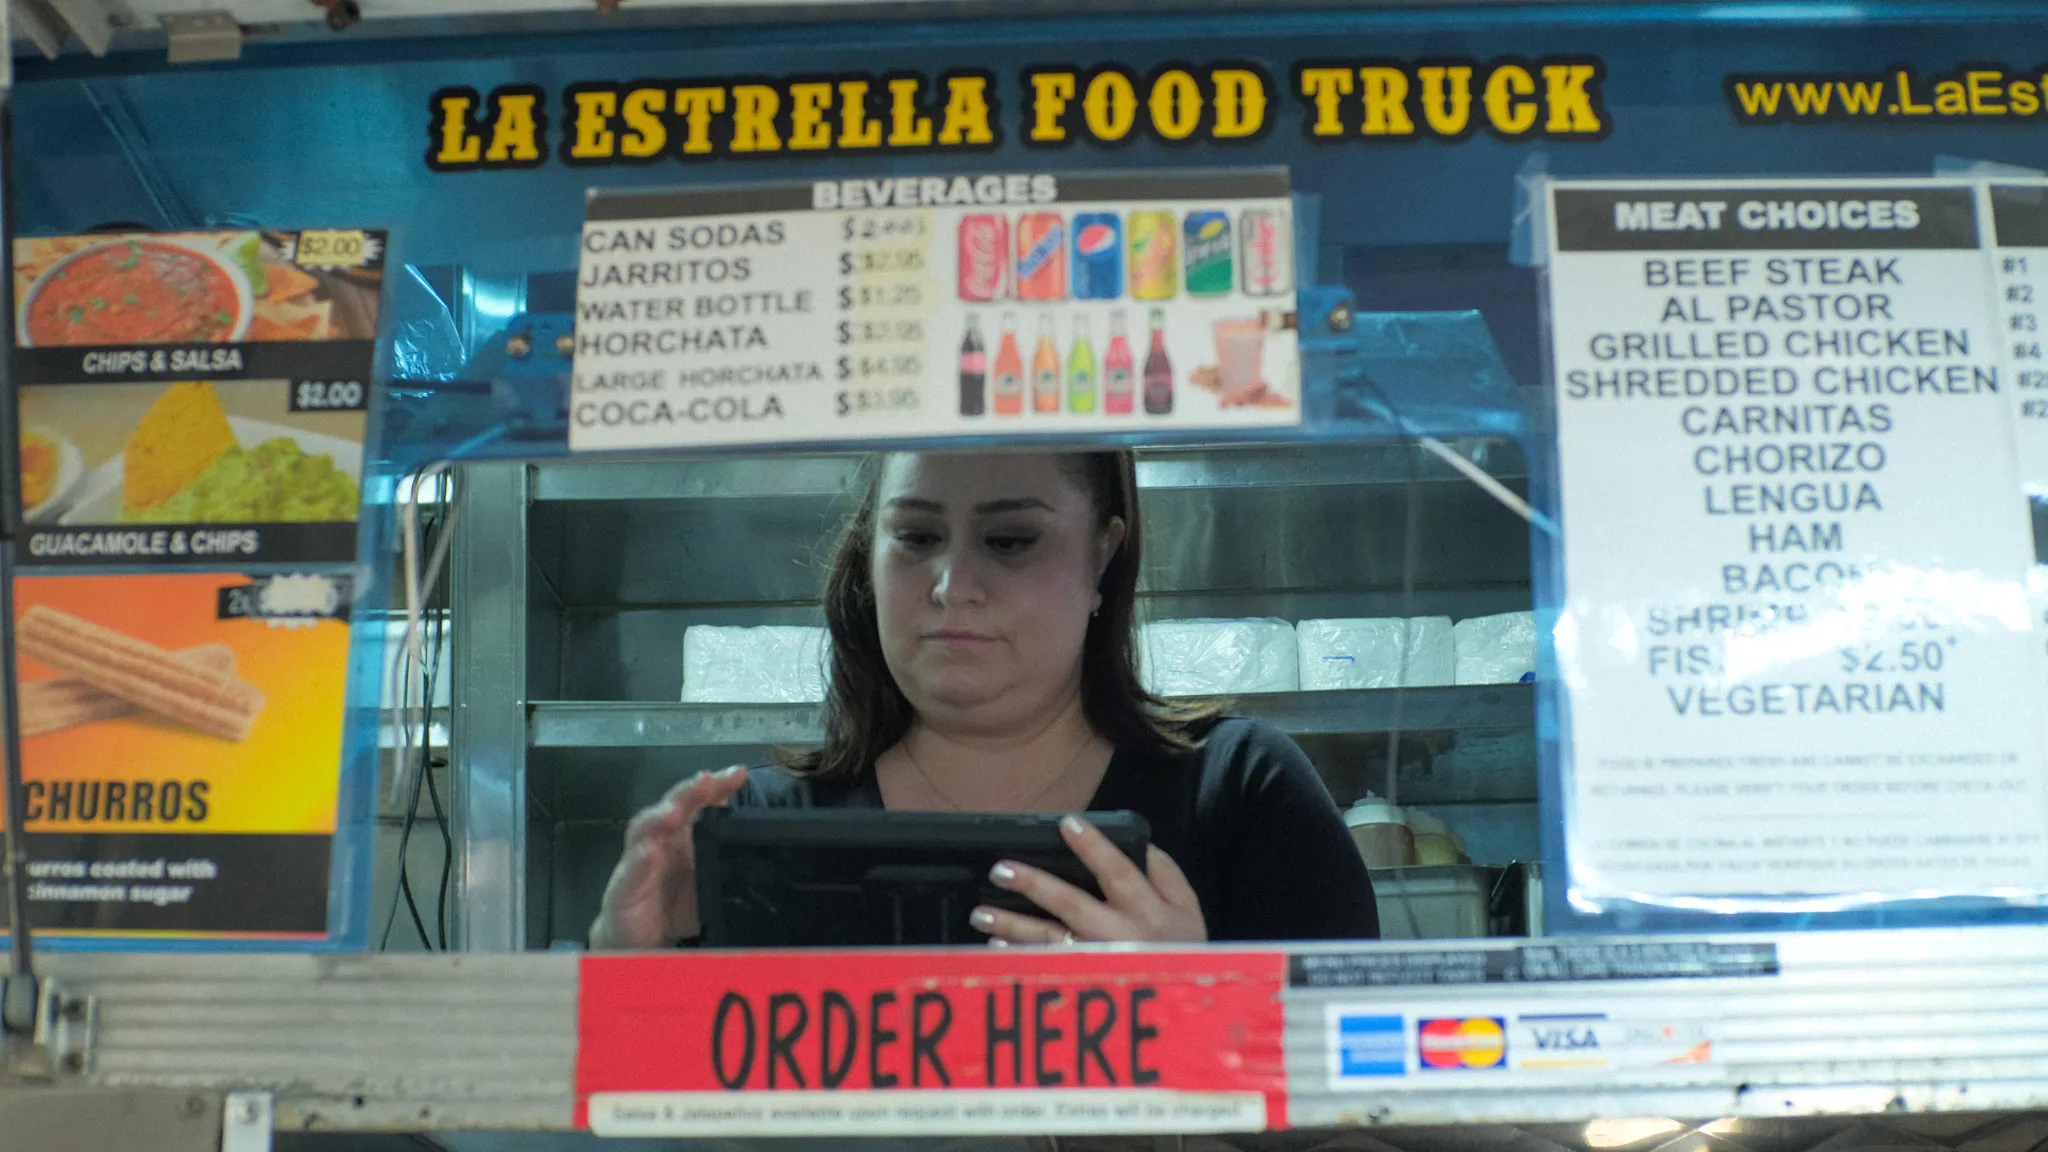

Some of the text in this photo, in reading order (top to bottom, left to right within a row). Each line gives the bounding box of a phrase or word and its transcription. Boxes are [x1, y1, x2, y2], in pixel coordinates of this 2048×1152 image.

[436, 64, 1601, 163] LA ESTRELLA FOOD TRUCK
[811, 174, 1058, 209] BEVERAGES
[1614, 199, 1921, 232] MEAT CHOICES
[583, 220, 786, 254] CAN SODAS
[581, 256, 752, 288] JARRITOS
[1643, 255, 1904, 288] BEEF STEAK
[2002, 257, 2028, 274] #1
[579, 289, 814, 322] WATER BOTTLE
[1659, 292, 1894, 324] AL PASTOR
[2005, 284, 2034, 303] #2
[2009, 312, 2038, 332] #3
[578, 323, 769, 358] HORCHATA
[1589, 327, 1971, 361] GRILLED CHICKEN
[2013, 341, 2042, 360] #4
[81, 348, 243, 375] CHIPS & SALSA
[574, 360, 824, 394] LARGE HORCHATA
[296, 382, 363, 409] $2.00
[1565, 365, 2001, 400] SHREDDED CHICKEN
[574, 394, 786, 428] COCA-COLA
[1680, 403, 1894, 437] CARNITAS
[1692, 441, 1888, 476] CHORIZO
[1703, 480, 1883, 517] LENGUA
[29, 530, 260, 556] GUACAMOLE & CHIPS
[1747, 520, 1843, 554] HAM
[1648, 644, 1725, 676] FIS
[1666, 682, 1947, 717] VEGETARIAN
[22, 779, 210, 823] CHURROS
[89, 857, 166, 880] coated
[167, 857, 219, 880] with
[129, 884, 195, 908] sugar
[711, 981, 1160, 1090] ORDER HERE
[1531, 1027, 1600, 1050] VISA
